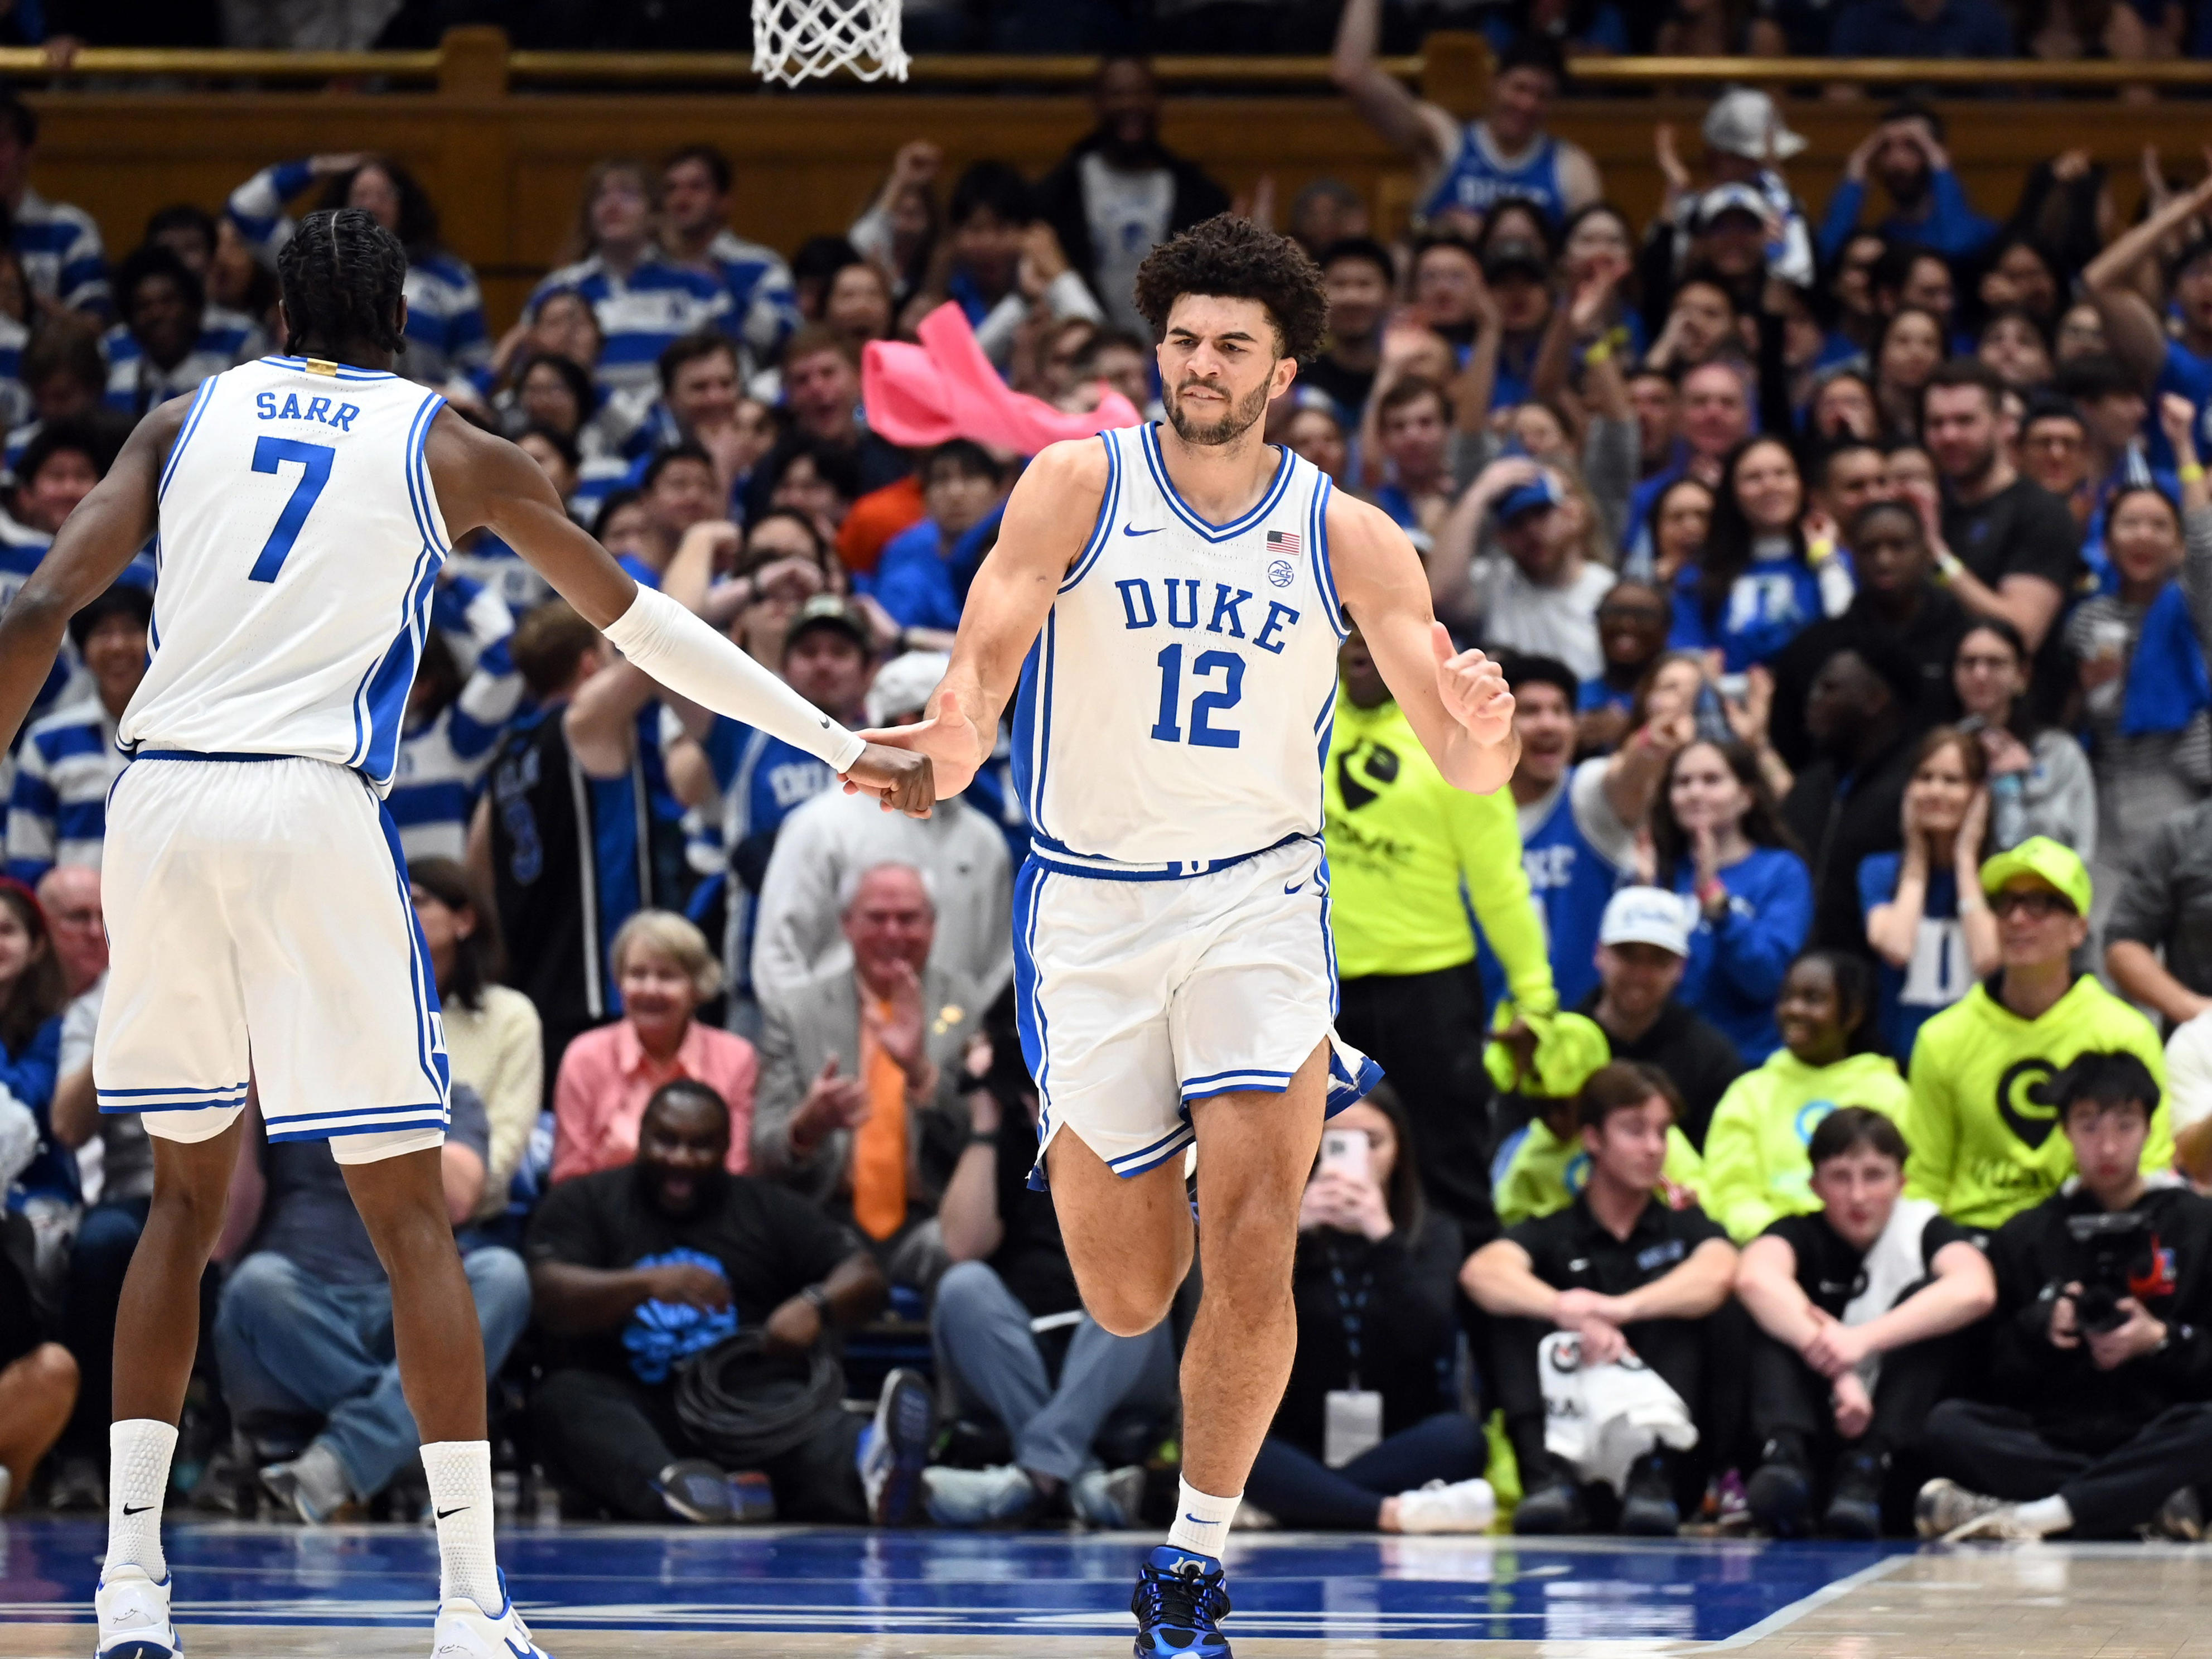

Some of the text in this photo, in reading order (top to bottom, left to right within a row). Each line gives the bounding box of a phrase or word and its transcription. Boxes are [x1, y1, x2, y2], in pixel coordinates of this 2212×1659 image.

[257, 392, 360, 432] SARR
[248, 436, 336, 583] 7
[1272, 569, 1293, 578] ACC
[1115, 578, 1300, 654] DUKE
[1151, 643, 1246, 749] 12
[769, 762, 838, 807] DU
